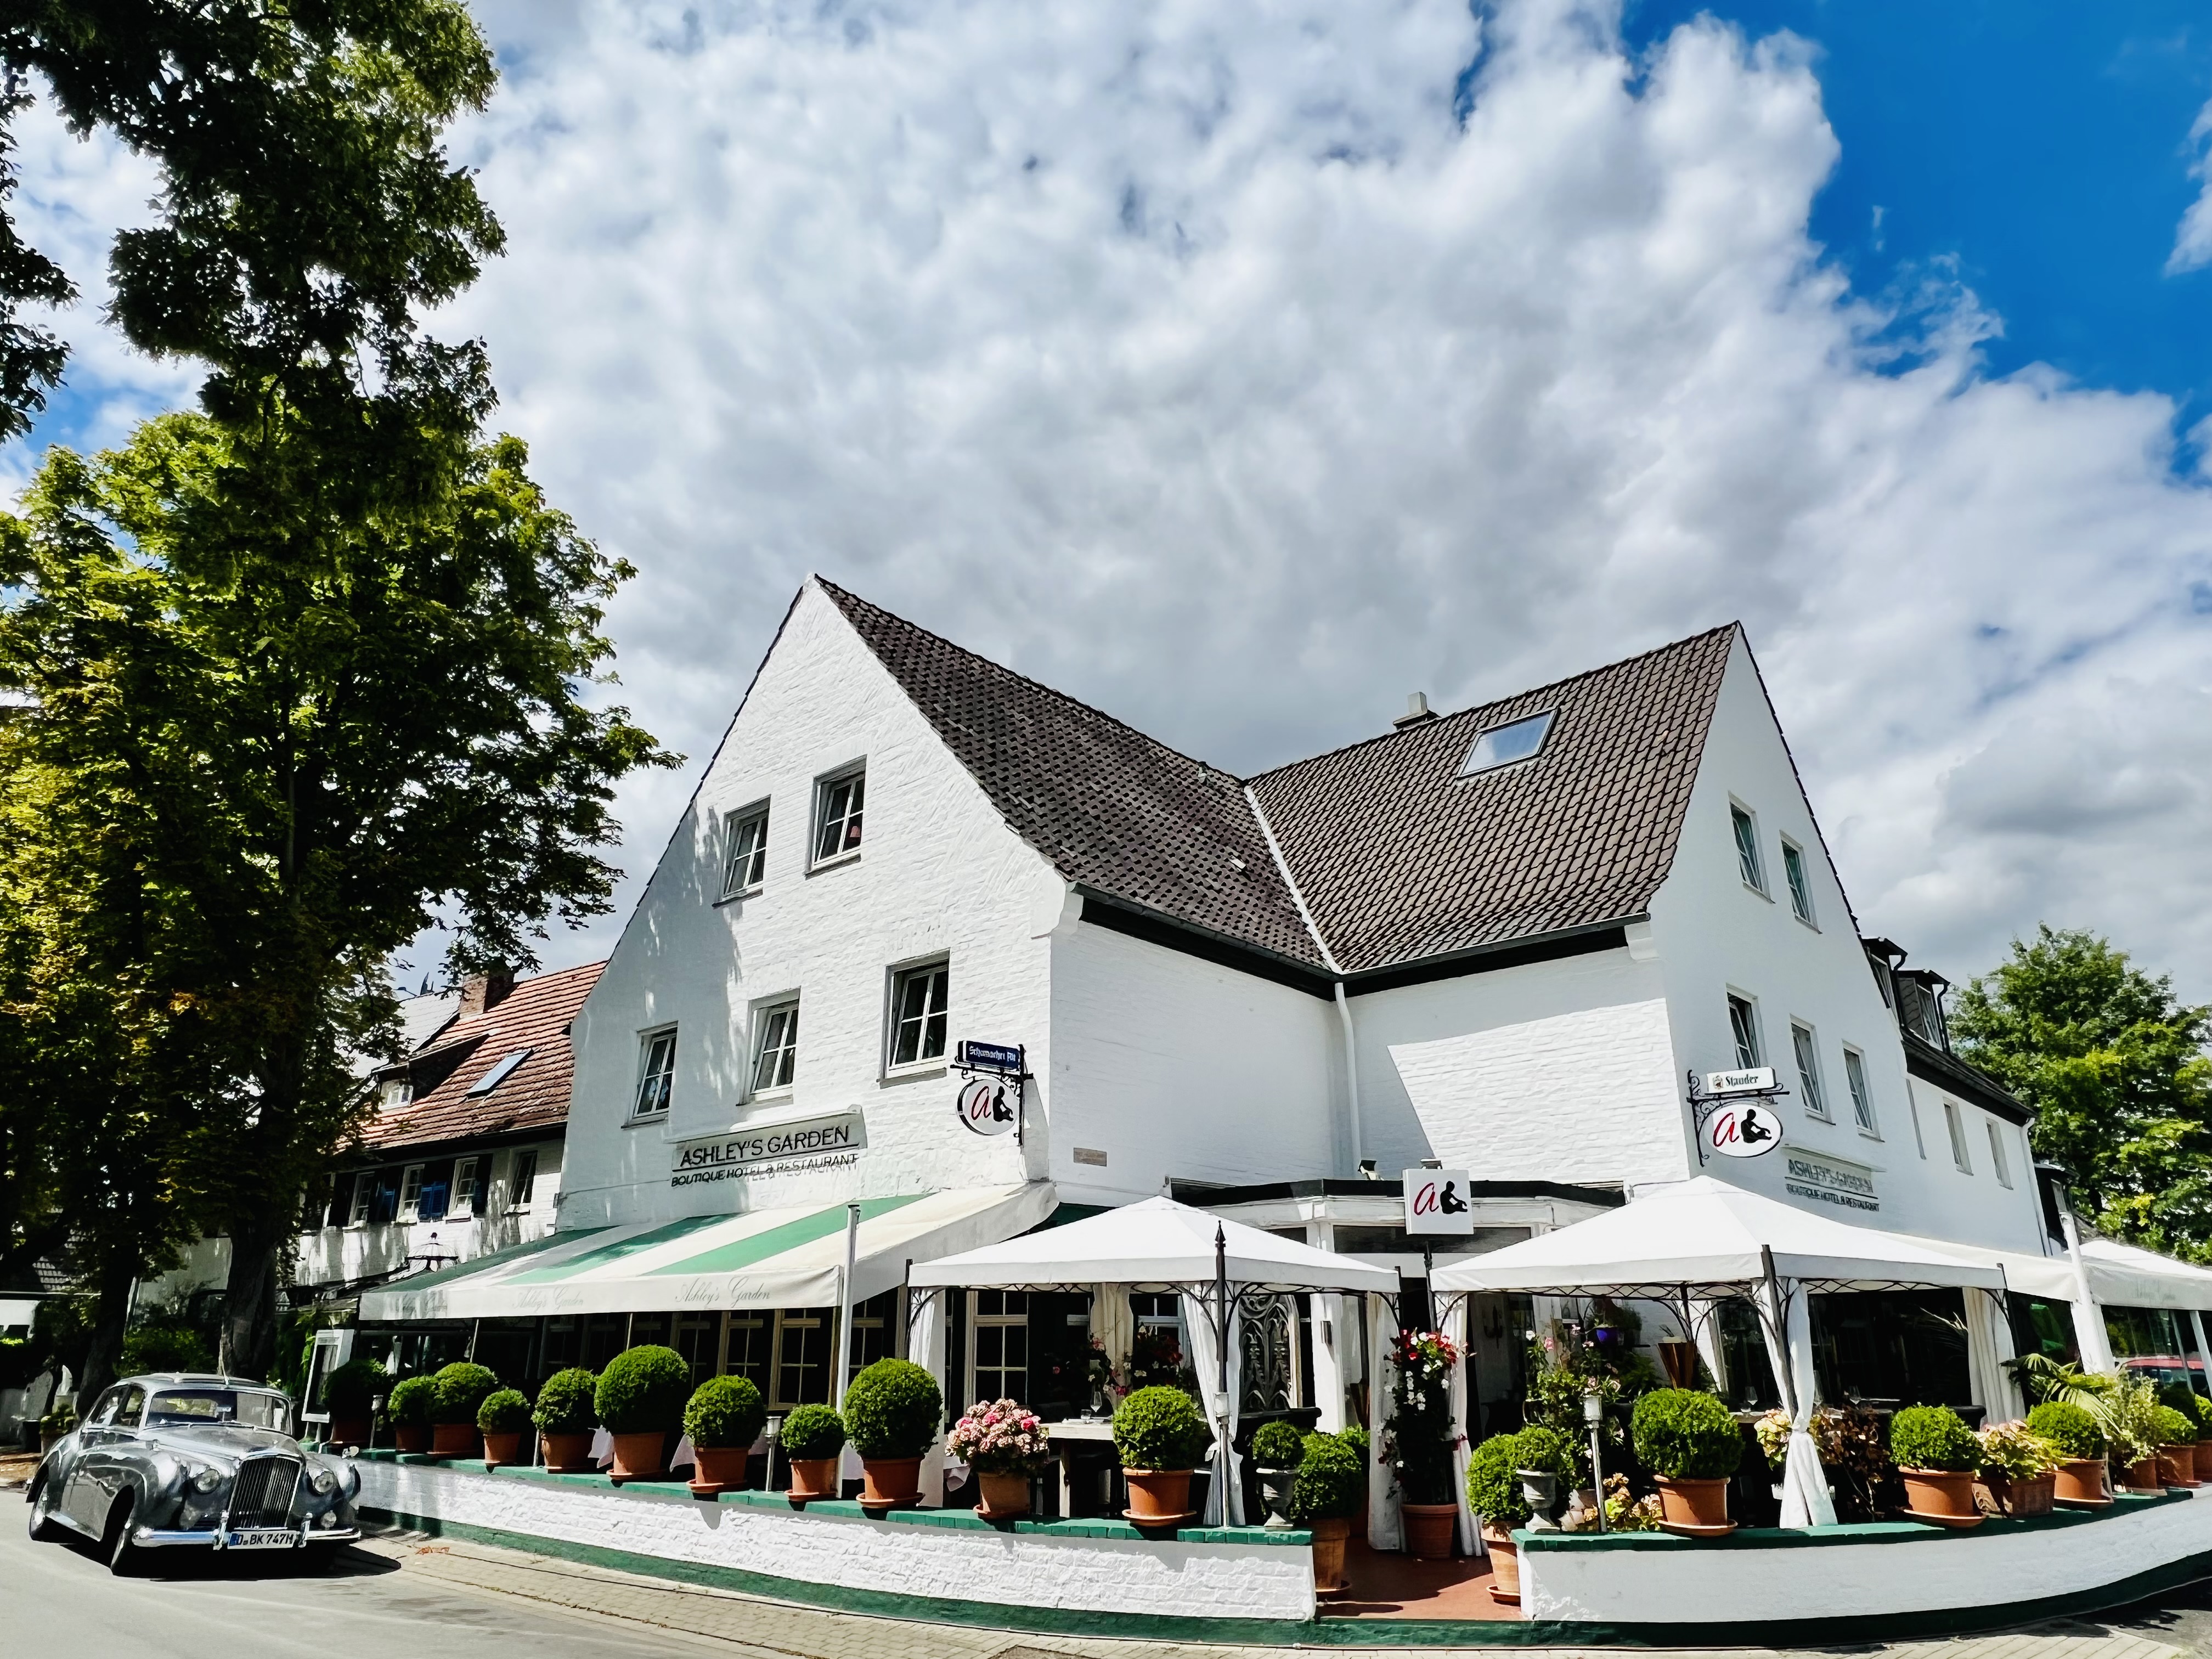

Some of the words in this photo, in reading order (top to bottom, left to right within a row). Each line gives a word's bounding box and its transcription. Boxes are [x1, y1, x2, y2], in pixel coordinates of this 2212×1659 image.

[1725, 1074, 1758, 1086] Stauder
[680, 1139, 763, 1166] ASHLEY'S
[768, 1125, 849, 1153] GARDEN
[671, 1169, 726, 1187] BOUTIQUE
[726, 1164, 761, 1178] HOTEL
[777, 1153, 860, 1171] RESTAURANT
[553, 1286, 584, 1312] Garden
[675, 1277, 719, 1310] Ashley's
[728, 1276, 770, 1308] Garden
[250, 1534, 265, 1545] BK
